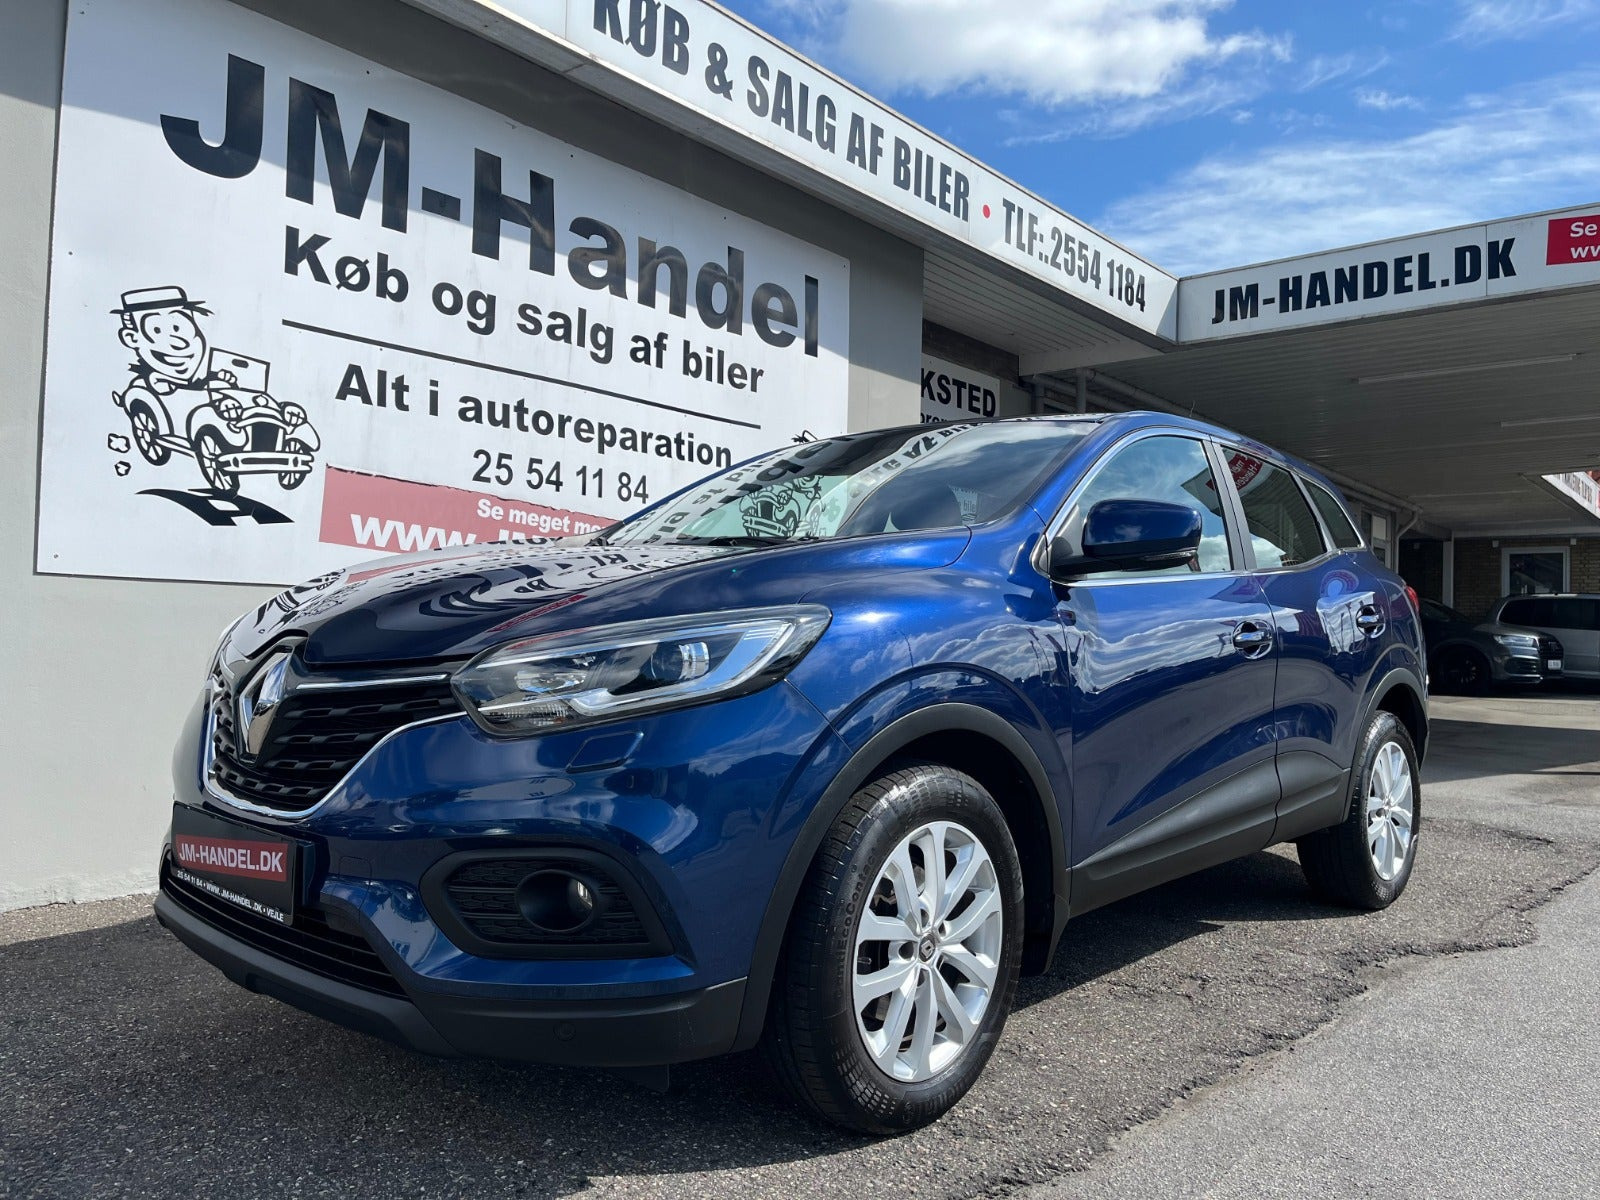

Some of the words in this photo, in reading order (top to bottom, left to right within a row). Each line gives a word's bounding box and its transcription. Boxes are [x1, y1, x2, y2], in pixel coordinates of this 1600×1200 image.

[704, 42, 734, 102] &
[746, 55, 837, 154] SALG
[846, 111, 885, 176] AF
[893, 135, 970, 223] BILER
[1106, 258, 1146, 313] 1184
[159, 53, 819, 358] JM-Handel
[1570, 221, 1598, 238] Se
[1211, 237, 1517, 325] JM-HANDEL.DK
[284, 225, 409, 303] Køb
[431, 282, 497, 336] og
[516, 302, 614, 365] salg
[629, 331, 669, 369] af
[682, 339, 765, 393] biler
[335, 363, 410, 412] Alt
[429, 378, 439, 417] i
[457, 394, 732, 469] autoreparation
[920, 367, 996, 418] KSTED
[472, 449, 514, 486] 25
[525, 457, 564, 493] 54
[575, 465, 604, 499] 11
[617, 471, 649, 504] 84
[476, 498, 504, 521] Se
[508, 508, 571, 534] meget
[179, 843, 283, 872] JM-HANDEL.DK
[177, 870, 184, 879] 25
[184, 873, 191, 881] 54
[196, 878, 203, 887] 84
[266, 908, 284, 922] VEJLE
